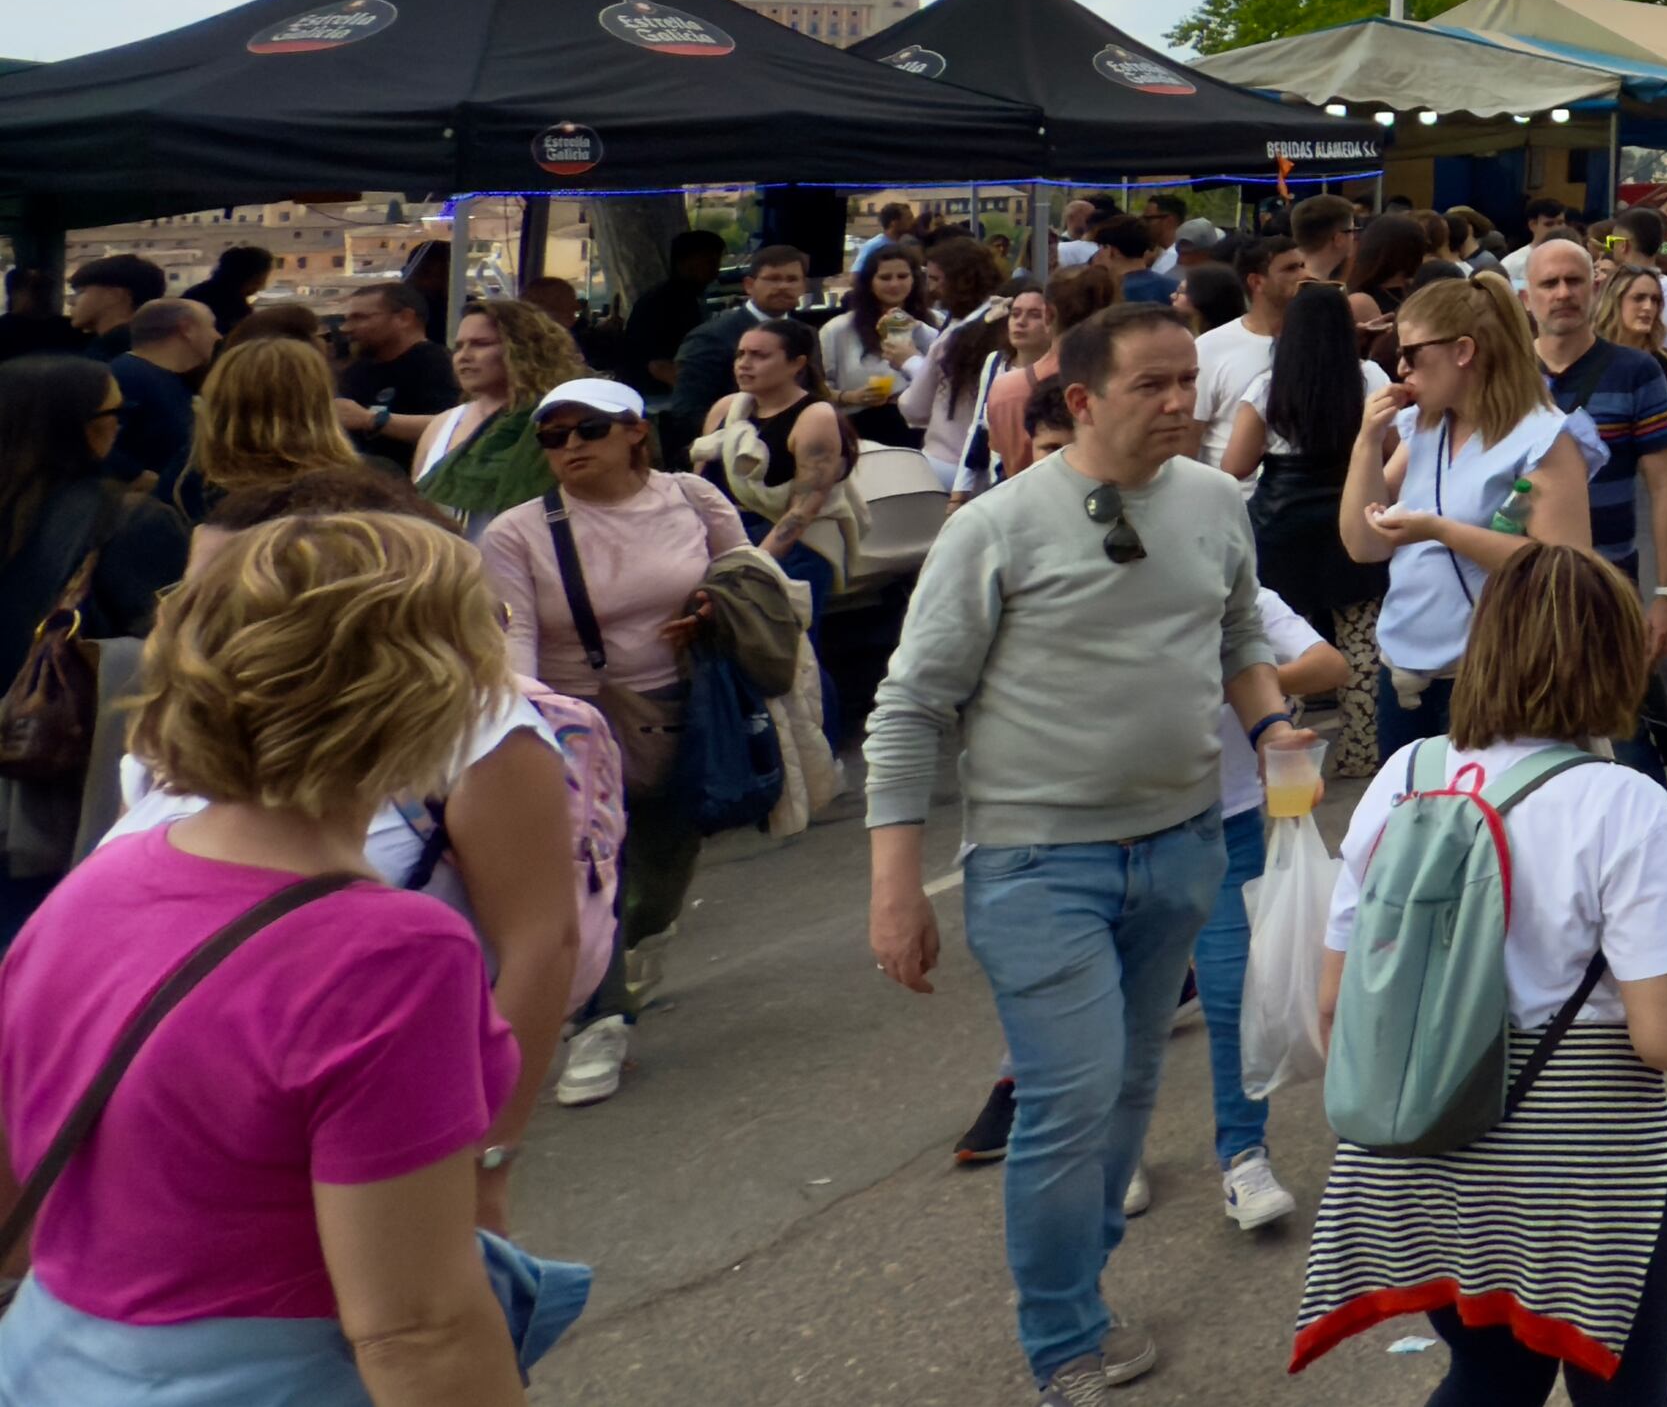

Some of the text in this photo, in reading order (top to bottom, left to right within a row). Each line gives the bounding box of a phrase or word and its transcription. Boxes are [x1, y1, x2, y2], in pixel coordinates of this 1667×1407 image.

[616, 14, 705, 31] Estrella
[635, 28, 717, 44] Galicia
[544, 135, 591, 148] Estrella
[1266, 140, 1314, 159] BEBIDAS
[1315, 140, 1362, 158] ALAMEDA
[546, 148, 590, 161] Galicia
